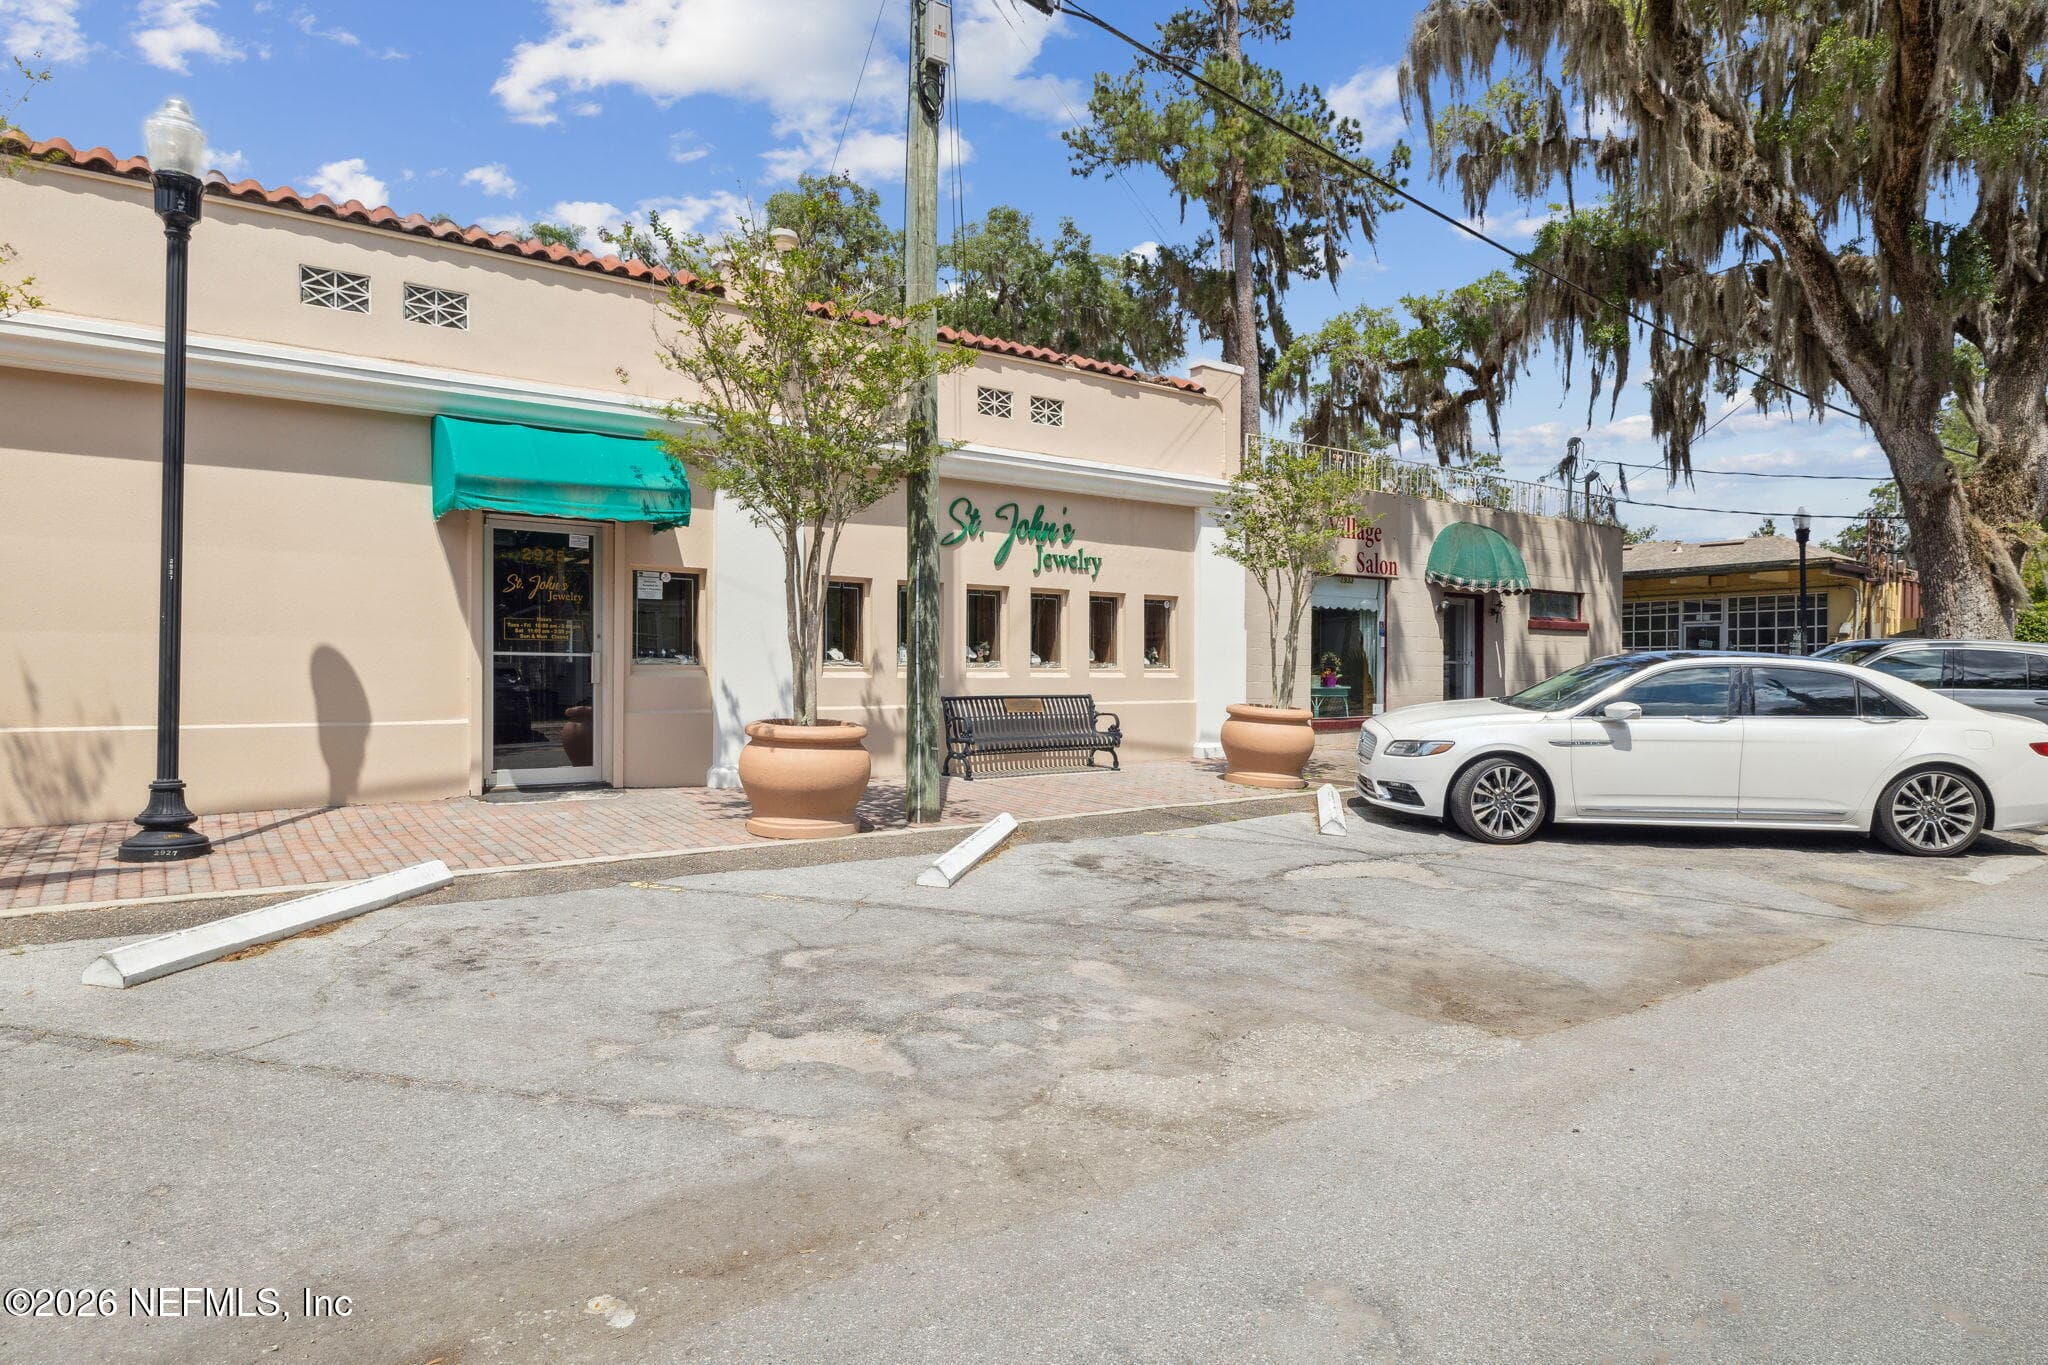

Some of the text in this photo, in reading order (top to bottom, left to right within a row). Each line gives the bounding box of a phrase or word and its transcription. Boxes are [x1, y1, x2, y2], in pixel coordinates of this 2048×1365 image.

[940, 497, 1075, 566] St. John's
[1032, 544, 1102, 578] Jewelry
[1356, 551, 1398, 576] Salon
[502, 573, 569, 599] St. John's
[548, 590, 584, 602] Jewelry
